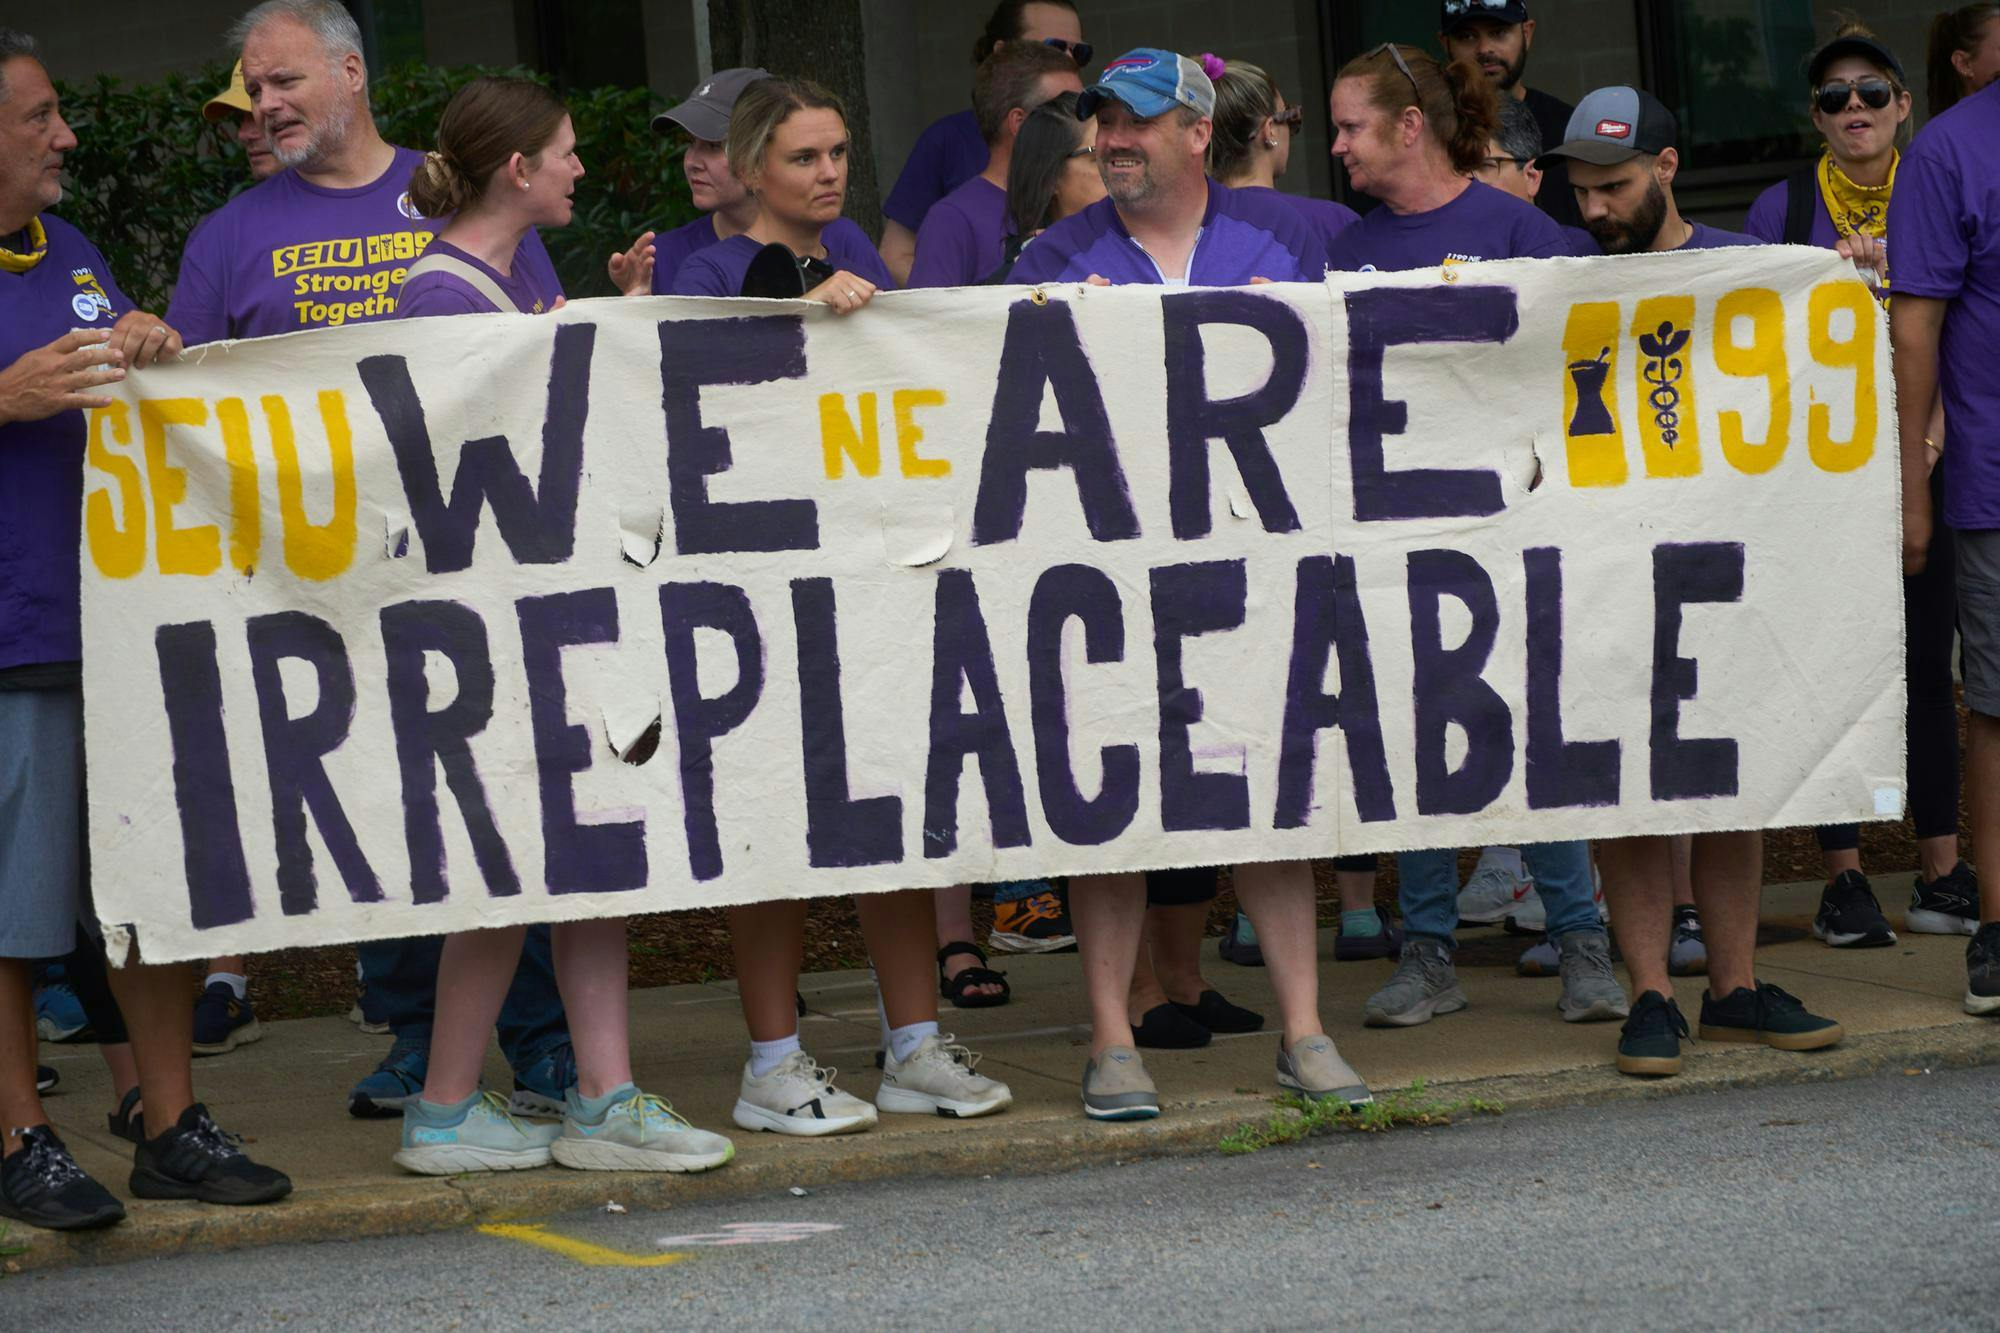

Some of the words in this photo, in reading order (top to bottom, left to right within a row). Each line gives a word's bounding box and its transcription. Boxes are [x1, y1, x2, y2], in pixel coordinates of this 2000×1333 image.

[276, 240, 359, 275] SEIU
[294, 267, 409, 295] Stronge
[294, 294, 398, 326] Togeth
[86, 389, 357, 582] SEIU
[818, 389, 952, 480] NE
[1562, 279, 1878, 488] 1199
[357, 314, 820, 574] WE
[970, 284, 1519, 547] ARE
[154, 541, 1745, 930] IRREPLACEABLE
